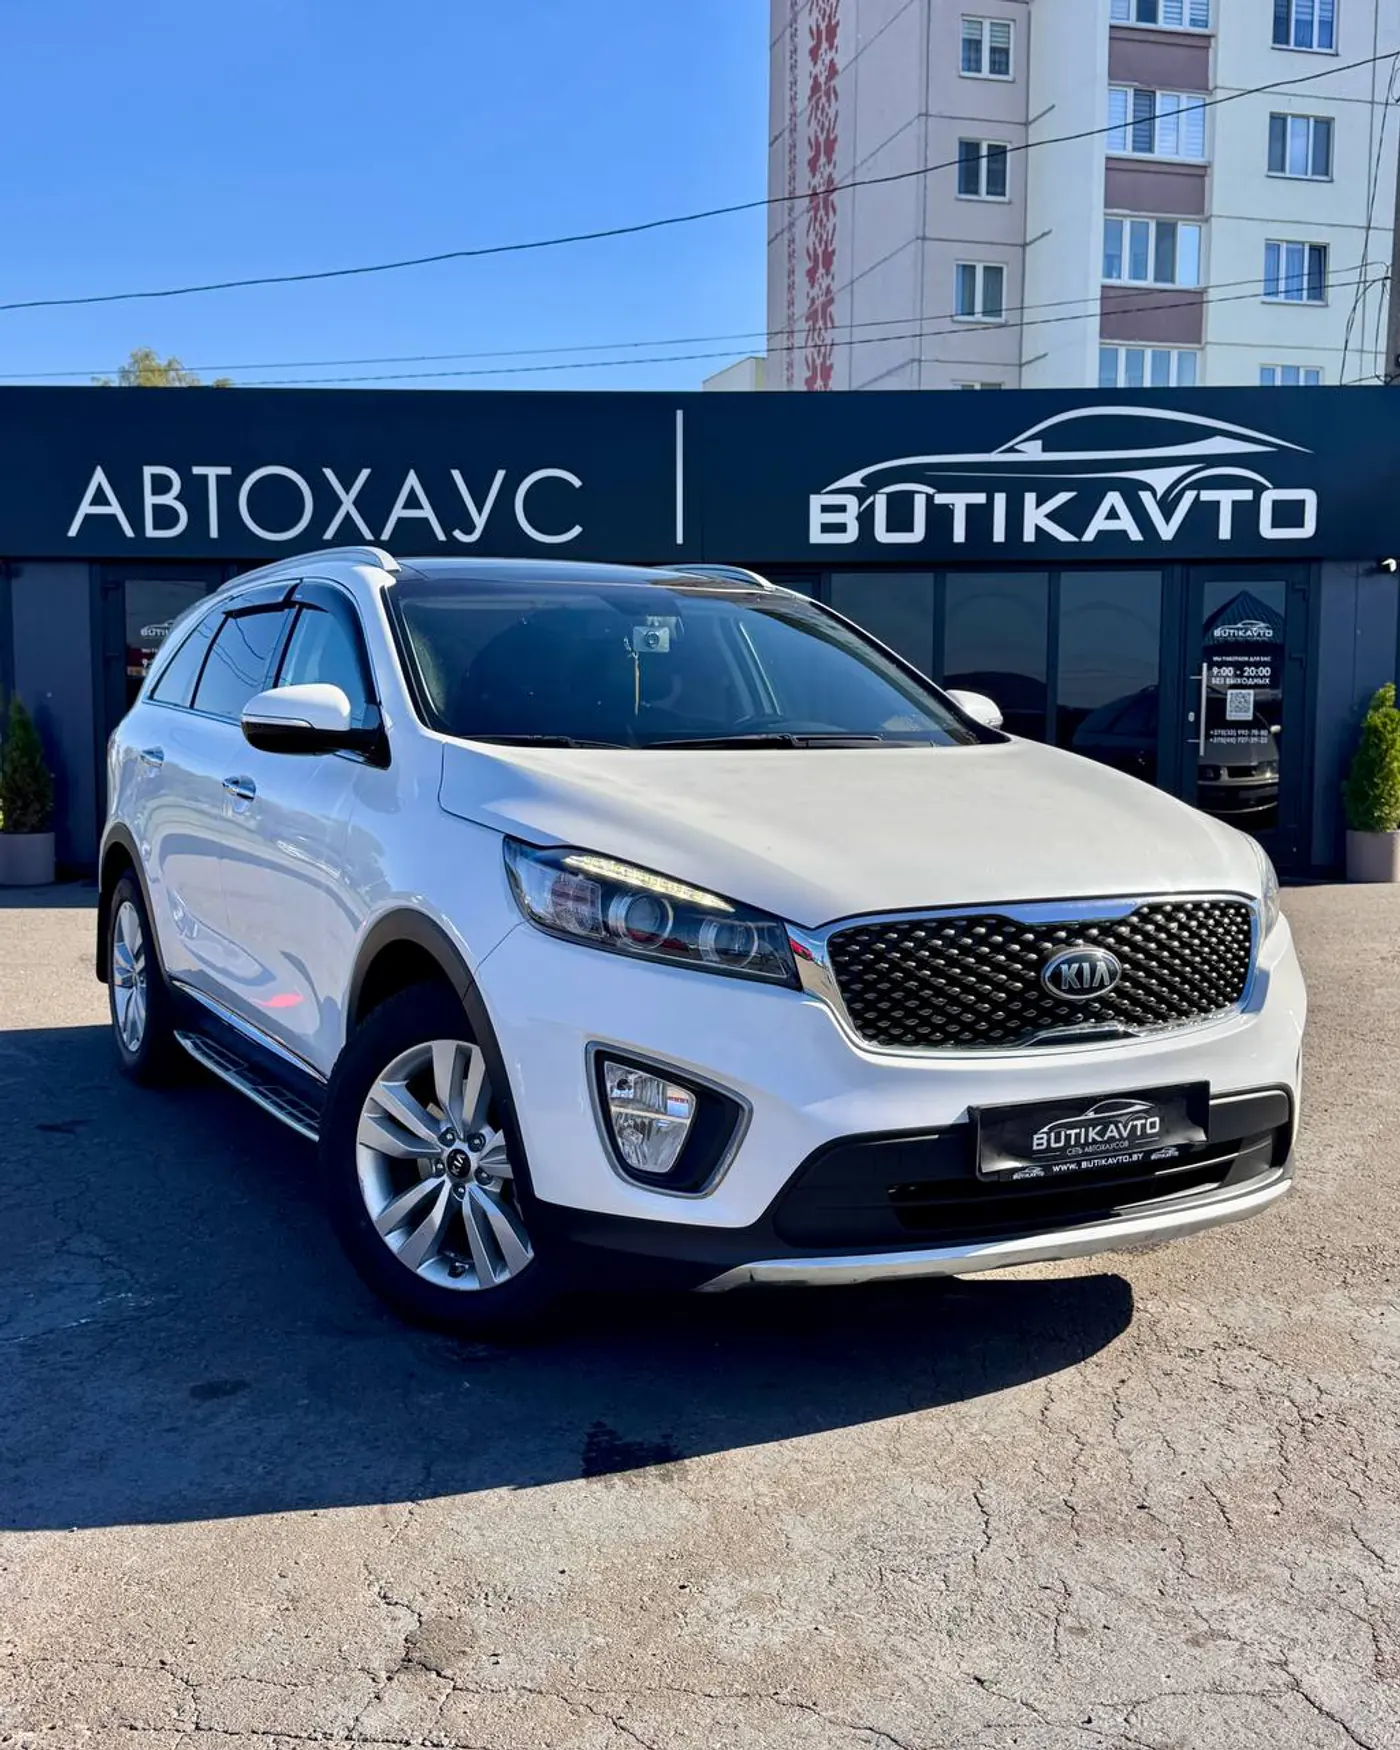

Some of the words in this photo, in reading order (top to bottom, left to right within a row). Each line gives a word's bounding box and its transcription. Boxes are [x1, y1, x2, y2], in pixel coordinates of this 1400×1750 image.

[66, 464, 584, 545] АВТОХАУС
[808, 487, 1318, 545] BUTIKAVTO
[1213, 628, 1274, 638] BUTIKAVTO
[1212, 666, 1234, 677] 9:00
[1243, 666, 1272, 677] 20:00
[1060, 961, 1111, 990] KIA
[1032, 1116, 1160, 1151] BUTIKAVTO
